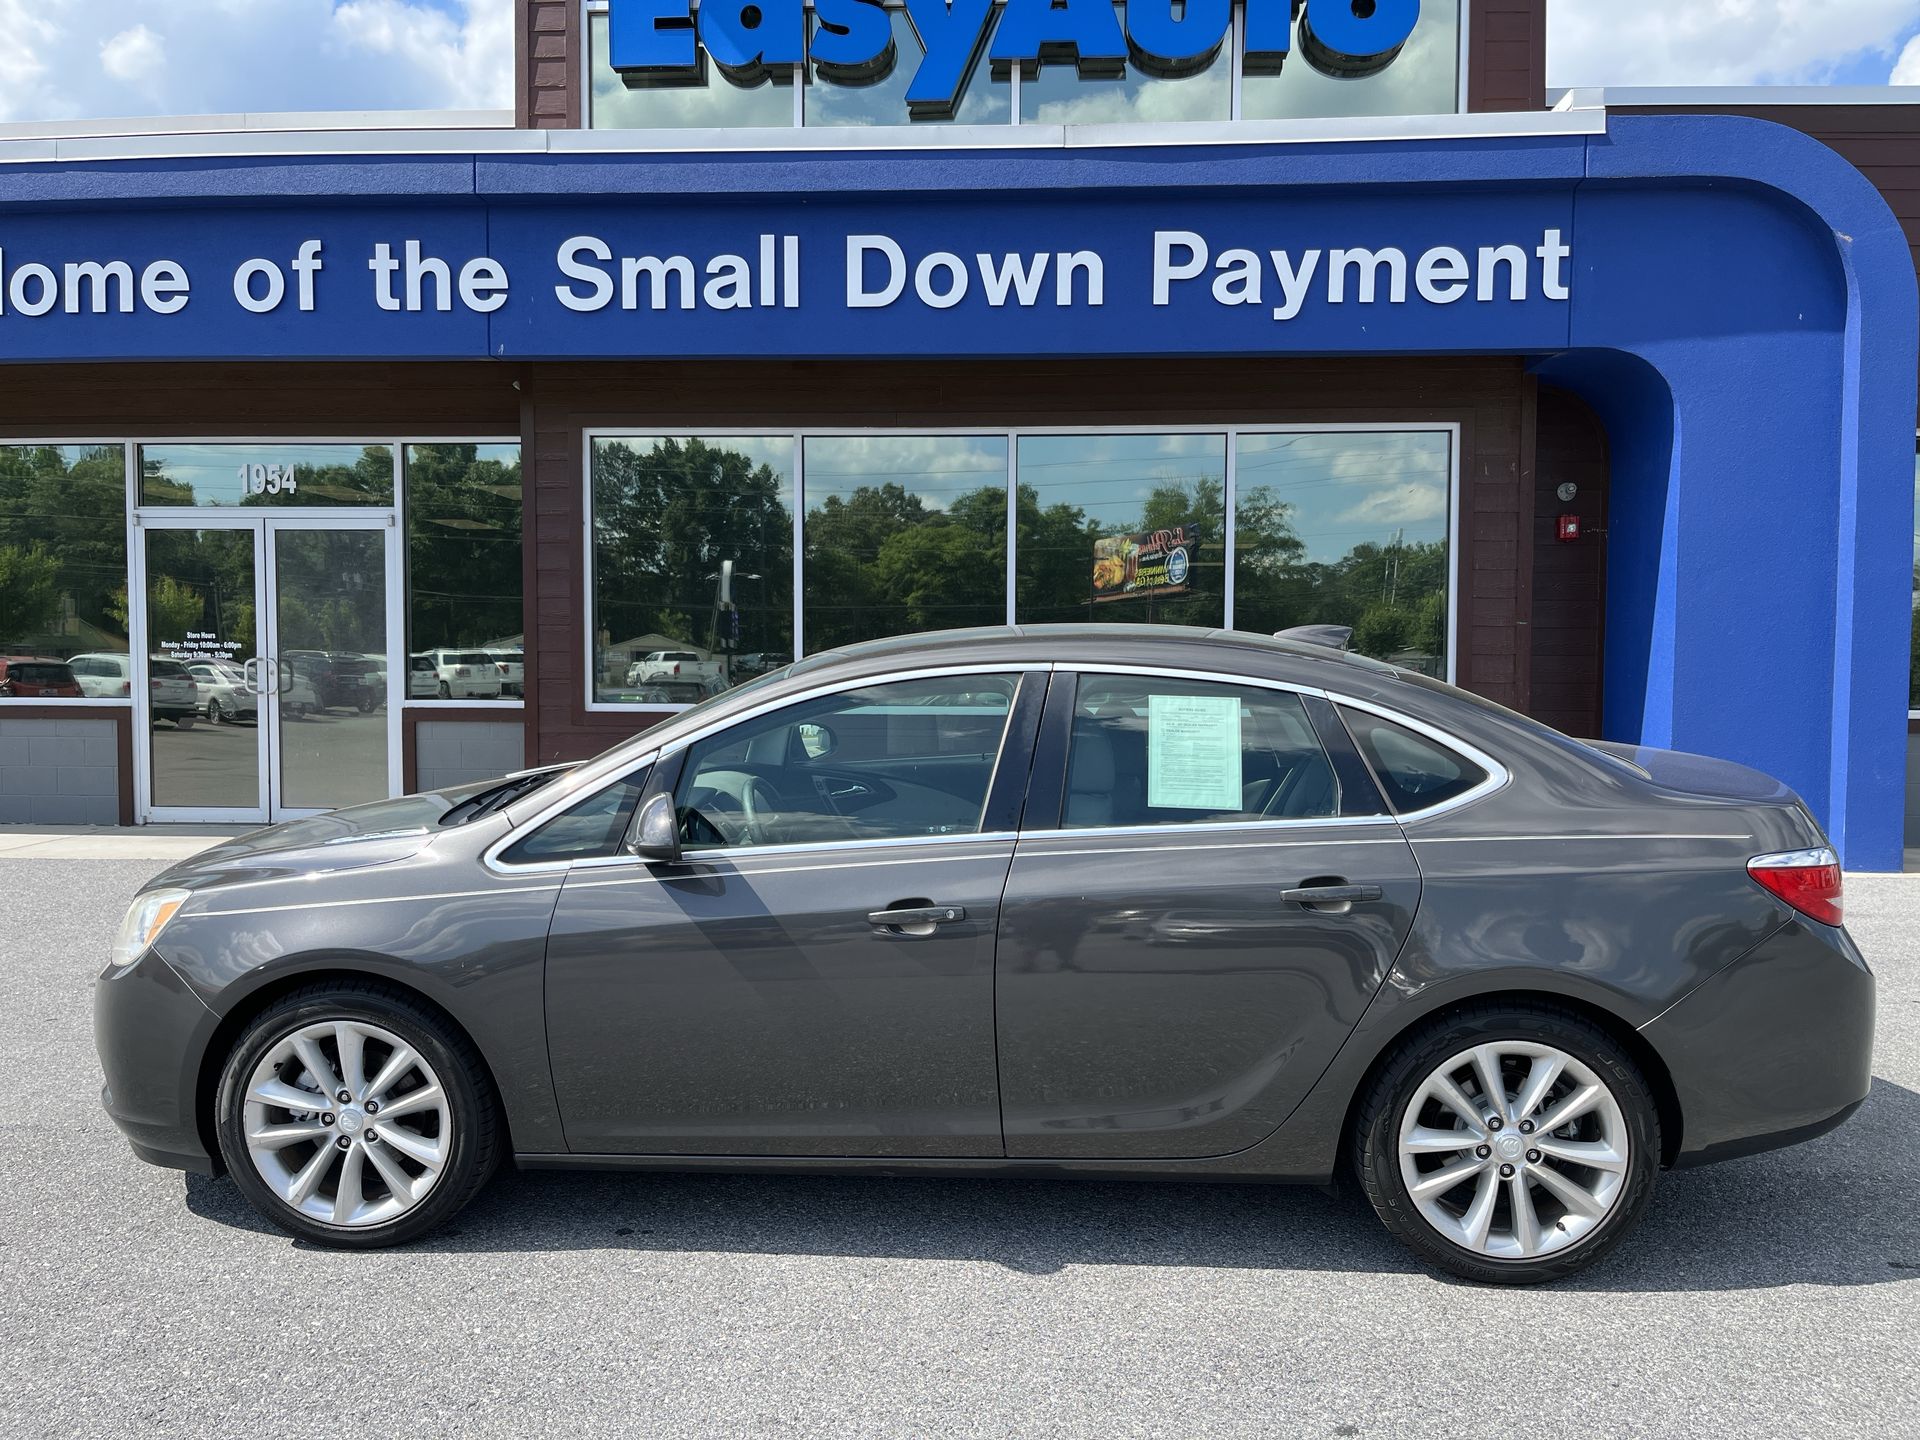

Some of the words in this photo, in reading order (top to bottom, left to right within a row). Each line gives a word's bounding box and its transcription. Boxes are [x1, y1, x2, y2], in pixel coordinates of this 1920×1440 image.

[0, 247, 190, 316] ome
[233, 239, 322, 313] of
[368, 240, 509, 312] the
[555, 234, 799, 312] Small
[846, 235, 1103, 308] Down
[1153, 229, 1570, 320] Payment
[238, 463, 297, 495] 1954
[186, 631, 200, 639] Store
[201, 631, 216, 639] Hours
[161, 641, 180, 650] Monday
[183, 641, 199, 650] Friday
[199, 641, 220, 649] 10:00am
[223, 641, 242, 650] 6:00pm
[170, 651, 193, 660] Saturday
